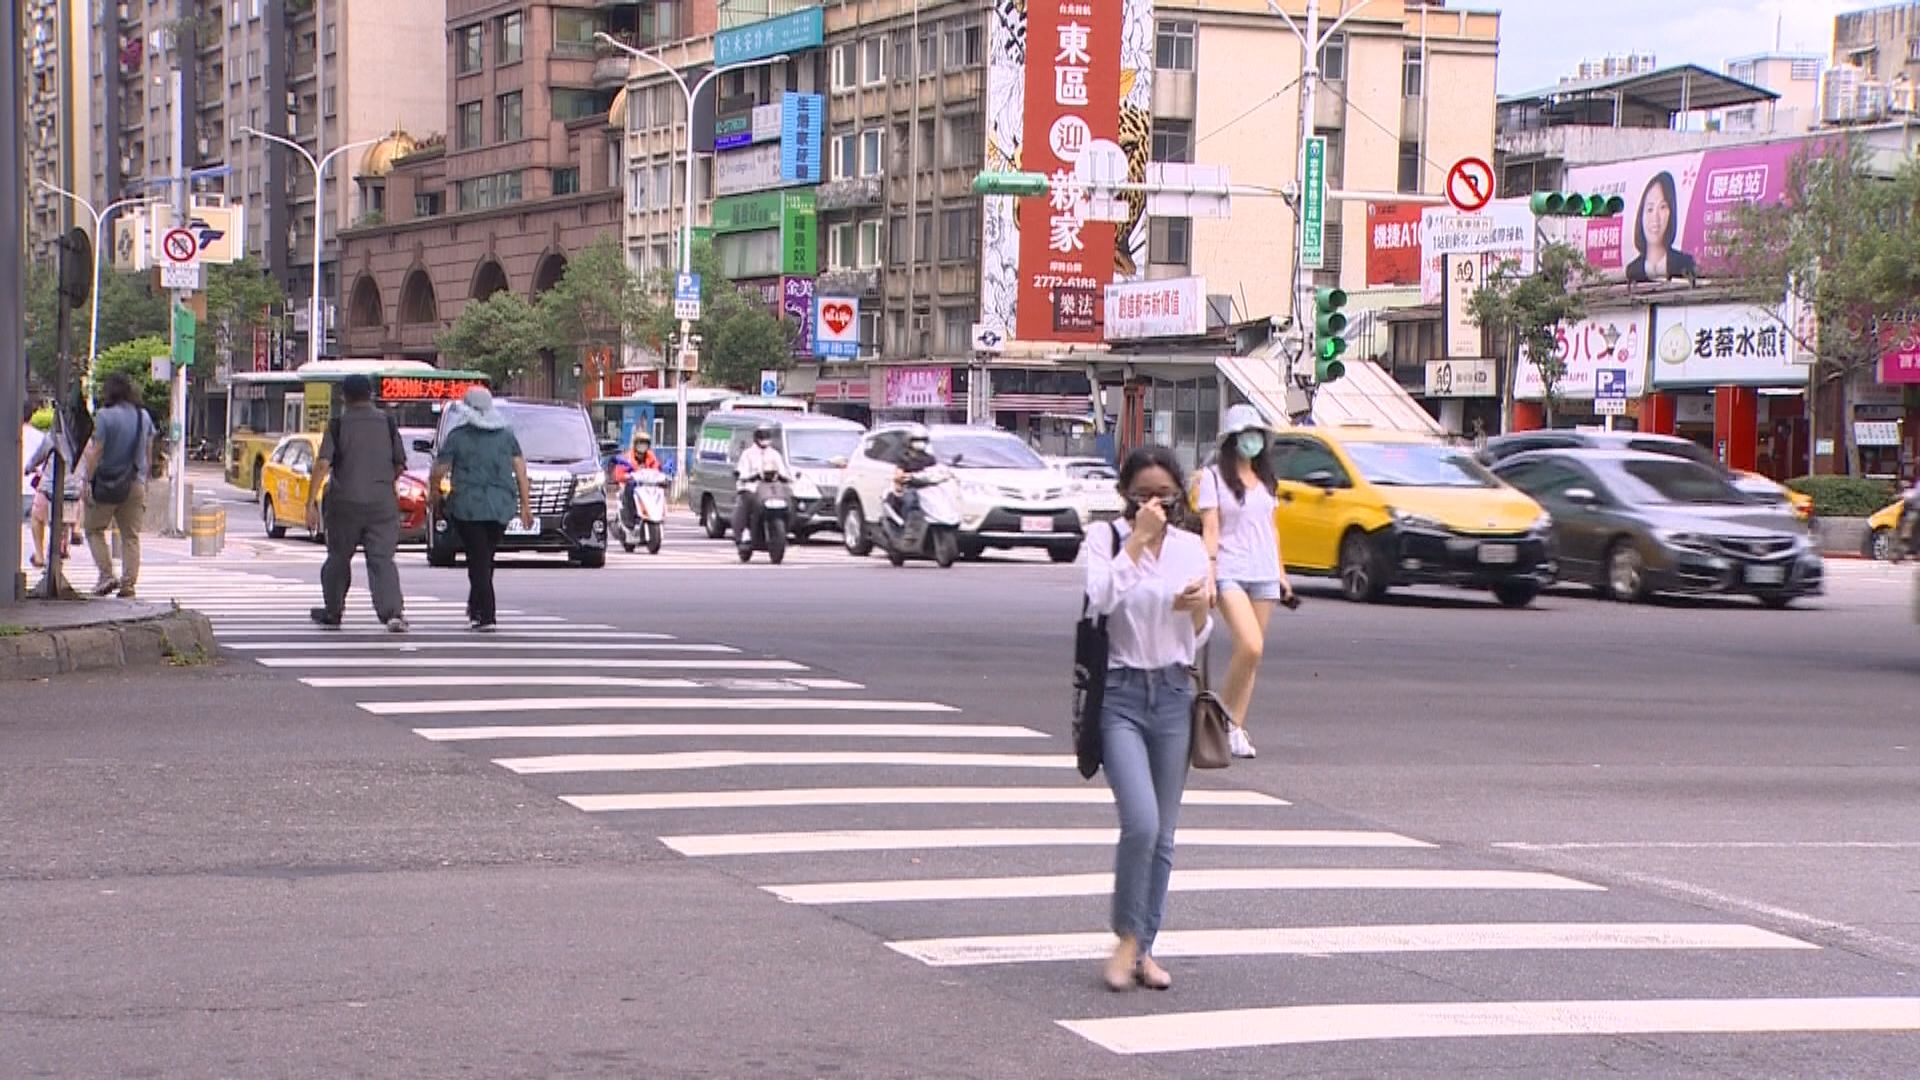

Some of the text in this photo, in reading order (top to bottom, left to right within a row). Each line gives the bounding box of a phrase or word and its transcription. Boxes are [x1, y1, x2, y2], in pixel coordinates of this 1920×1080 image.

[1711, 170, 1762, 197] 聯絡站
[1060, 292, 1094, 317] 樂法
[1118, 289, 1180, 320] 創造都市新價值
[1694, 325, 1785, 358] 老蔡水煎
